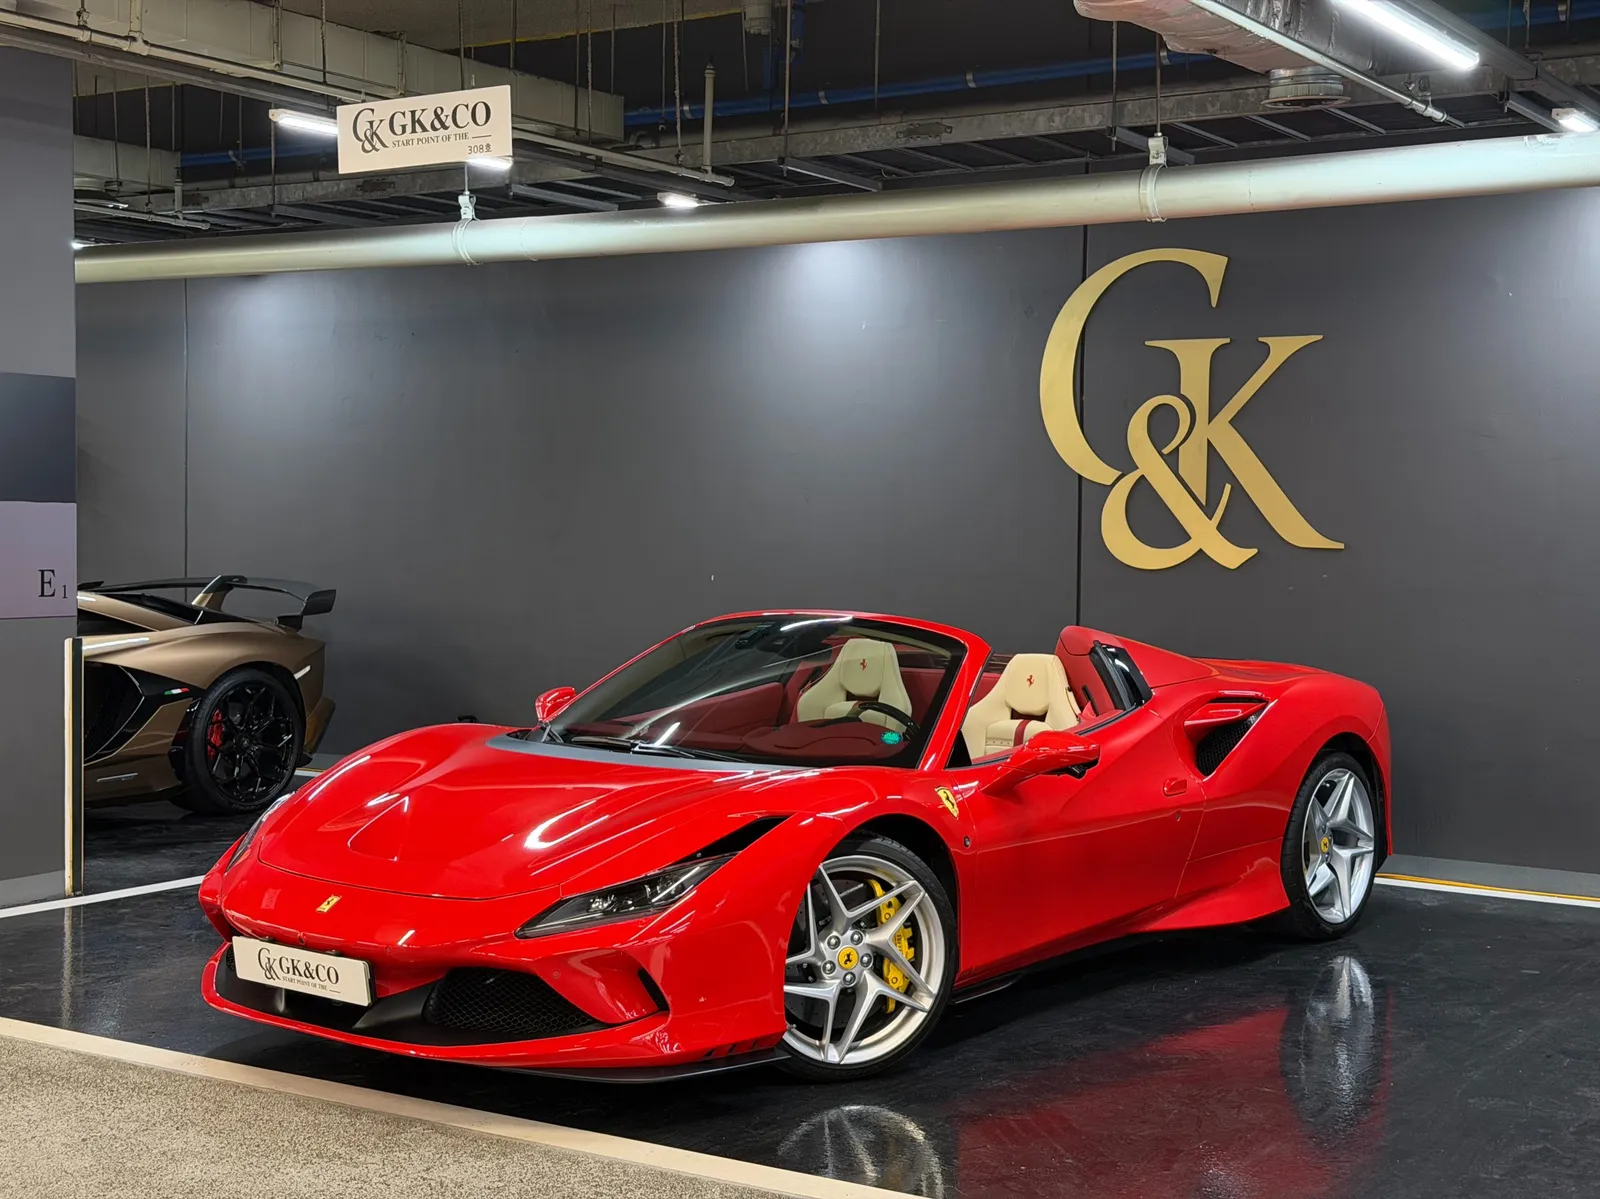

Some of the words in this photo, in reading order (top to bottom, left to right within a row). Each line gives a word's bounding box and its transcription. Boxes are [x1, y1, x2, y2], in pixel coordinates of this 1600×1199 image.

[388, 101, 491, 136] GK&CO
[392, 138, 415, 148] START
[416, 135, 440, 146] POINT
[441, 134, 451, 143] OF
[453, 132, 470, 141] THE
[467, 143, 492, 155] 308호
[279, 956, 339, 985] GK&CO
[296, 979, 310, 987] POINT
[318, 983, 328, 991] THE
